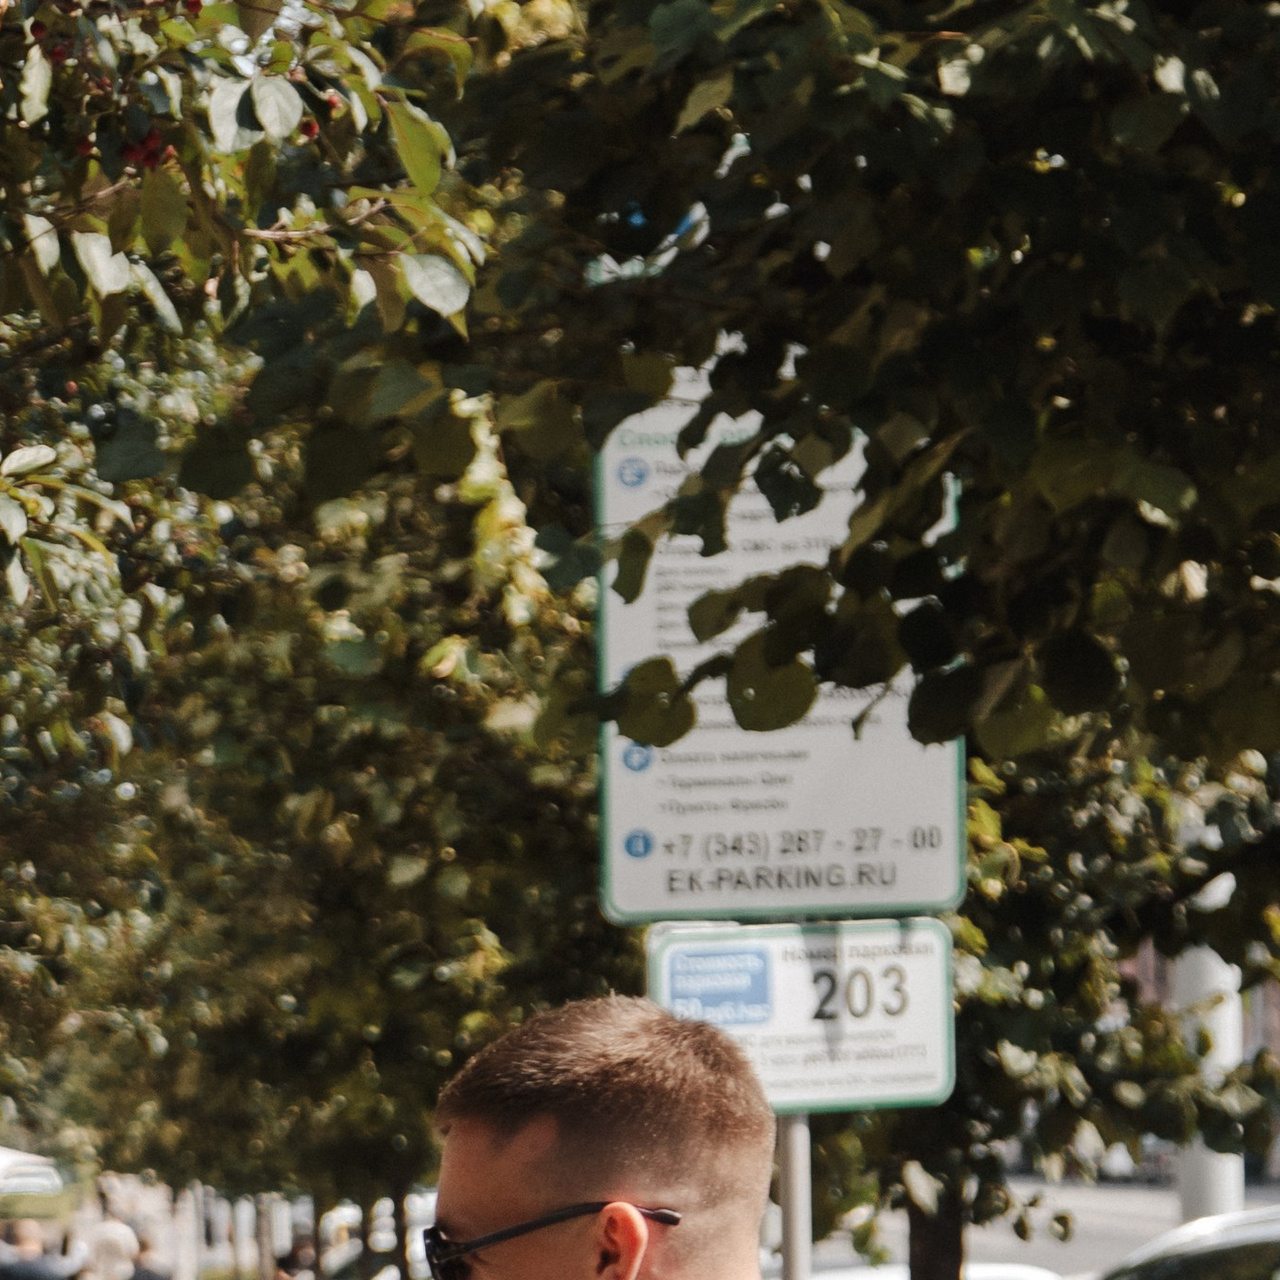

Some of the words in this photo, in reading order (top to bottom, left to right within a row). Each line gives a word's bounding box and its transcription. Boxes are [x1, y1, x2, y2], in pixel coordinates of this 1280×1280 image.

[663, 832, 693, 857] +7
[852, 826, 883, 852] 27
[912, 825, 942, 850] 00
[666, 862, 897, 894] EK-PARKING.RU
[811, 963, 908, 1020] 203
